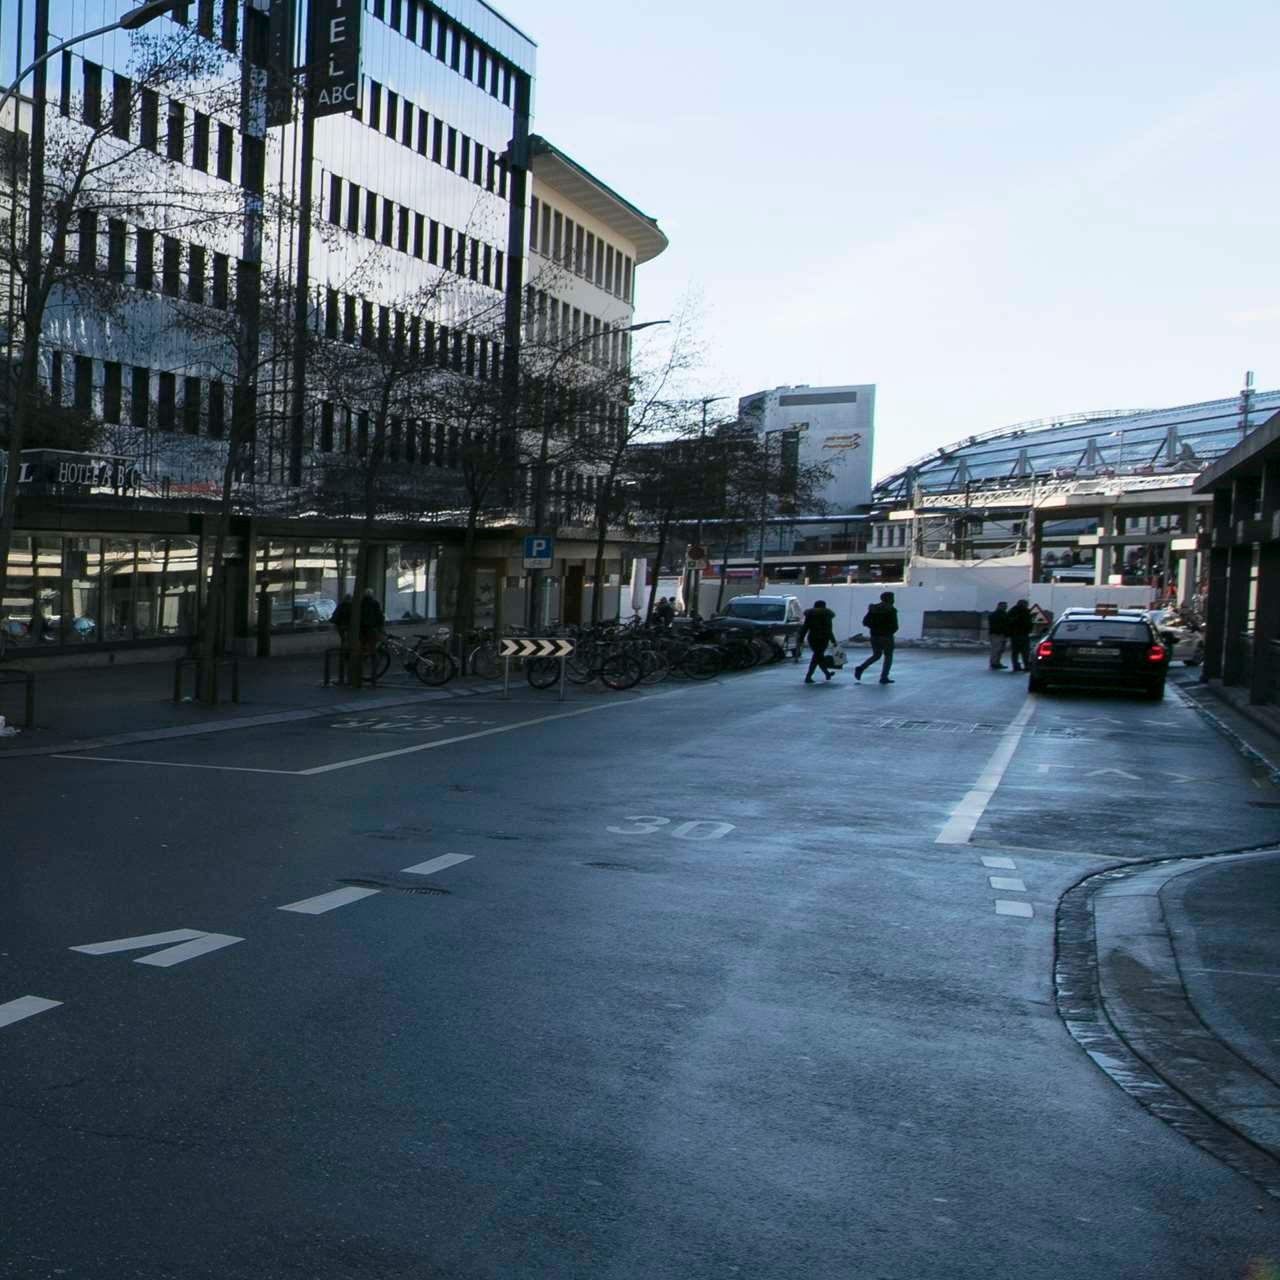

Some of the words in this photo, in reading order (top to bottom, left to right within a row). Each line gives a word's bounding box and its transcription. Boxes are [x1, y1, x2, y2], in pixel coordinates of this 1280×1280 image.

[318, 82, 356, 107] ABC
[532, 539, 546, 557] P
[606, 815, 736, 841] 30
